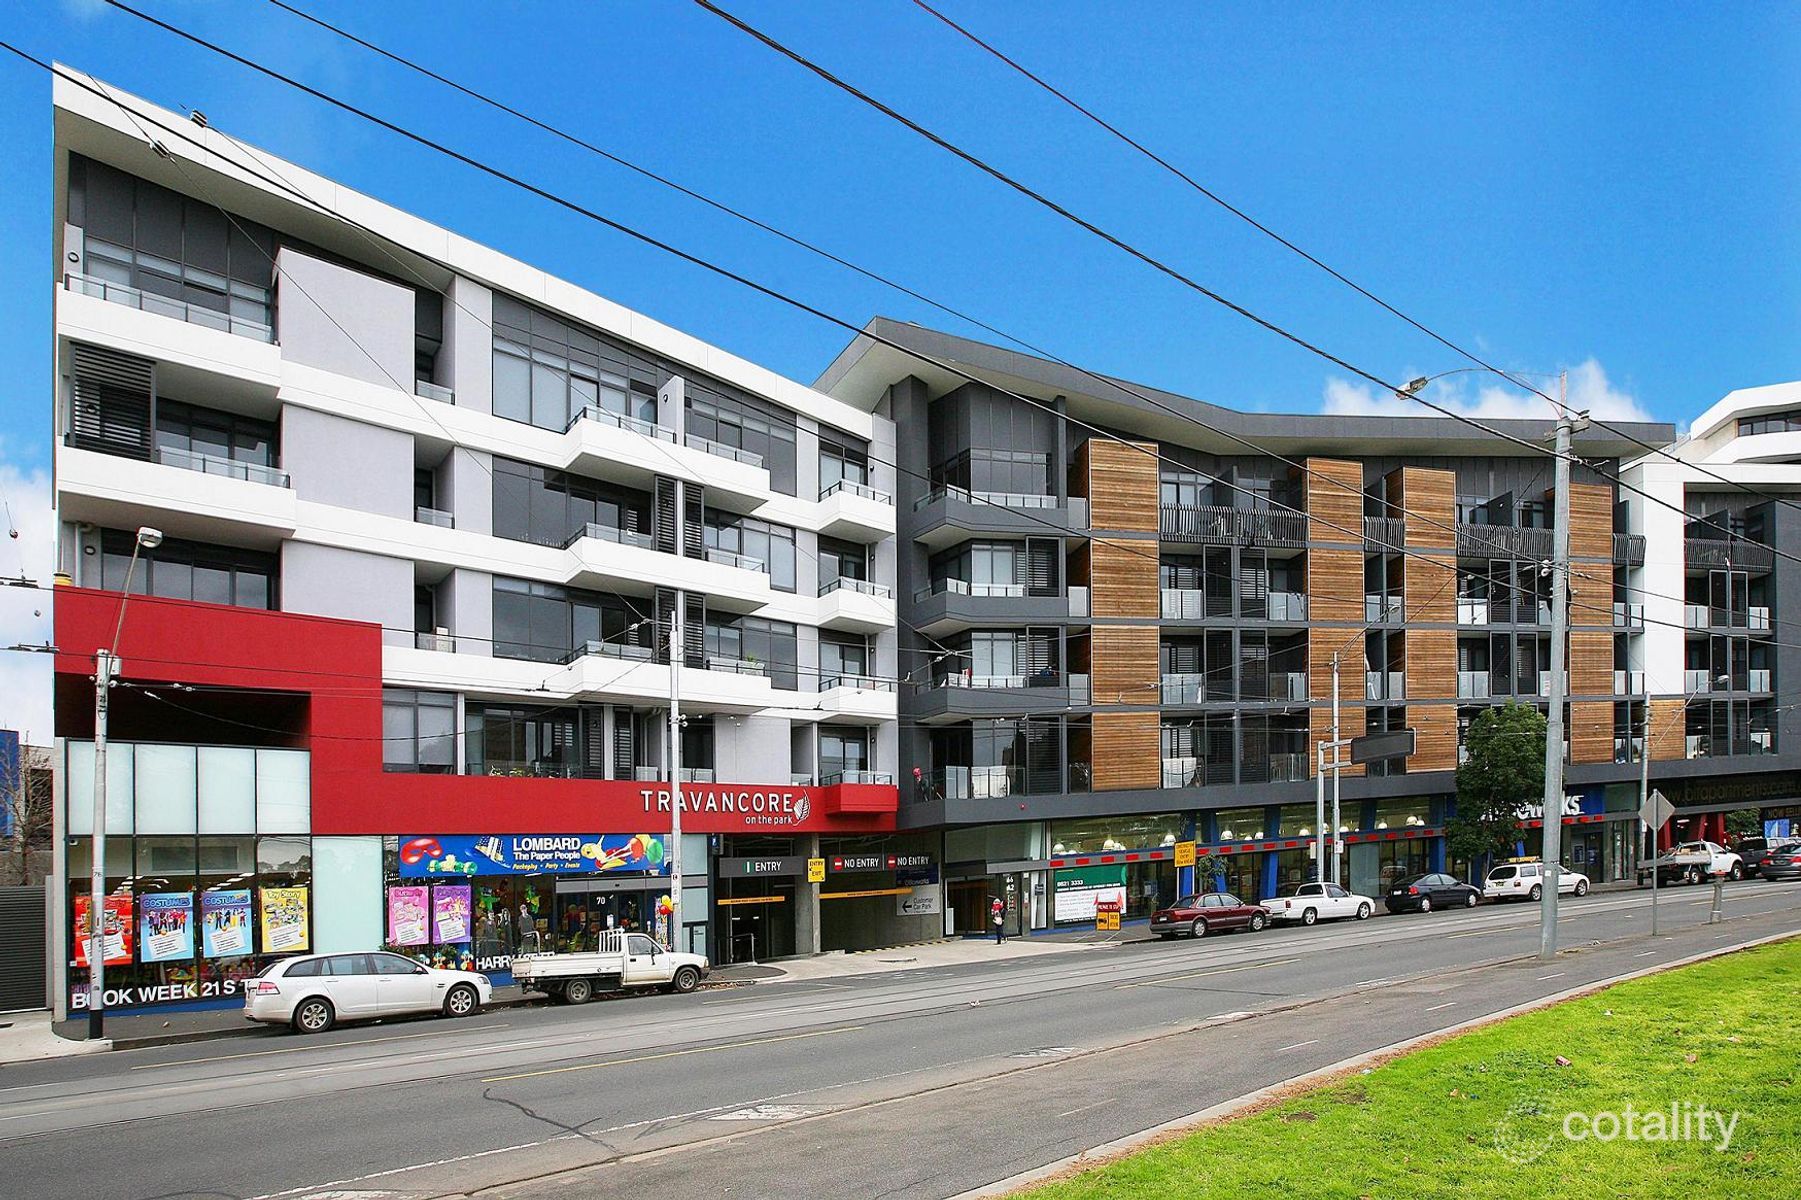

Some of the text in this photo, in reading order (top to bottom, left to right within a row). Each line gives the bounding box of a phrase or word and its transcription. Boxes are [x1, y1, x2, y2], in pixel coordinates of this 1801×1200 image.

[640, 790, 793, 813] TRAVANCORE
[745, 815, 792, 826] on the park
[513, 838, 580, 851] LOMBARD
[513, 851, 580, 862] The Paper People
[897, 856, 930, 866] NO ENTRY
[755, 861, 782, 872] ENTRY
[844, 858, 879, 868] NO ENTRY
[204, 893, 249, 905] COSTUMES
[267, 889, 301, 900] Toy Story
[596, 896, 606, 905] 70
[475, 953, 514, 970] HARRY
[72, 988, 133, 1009] BOK
[138, 982, 198, 1003] WEEK
